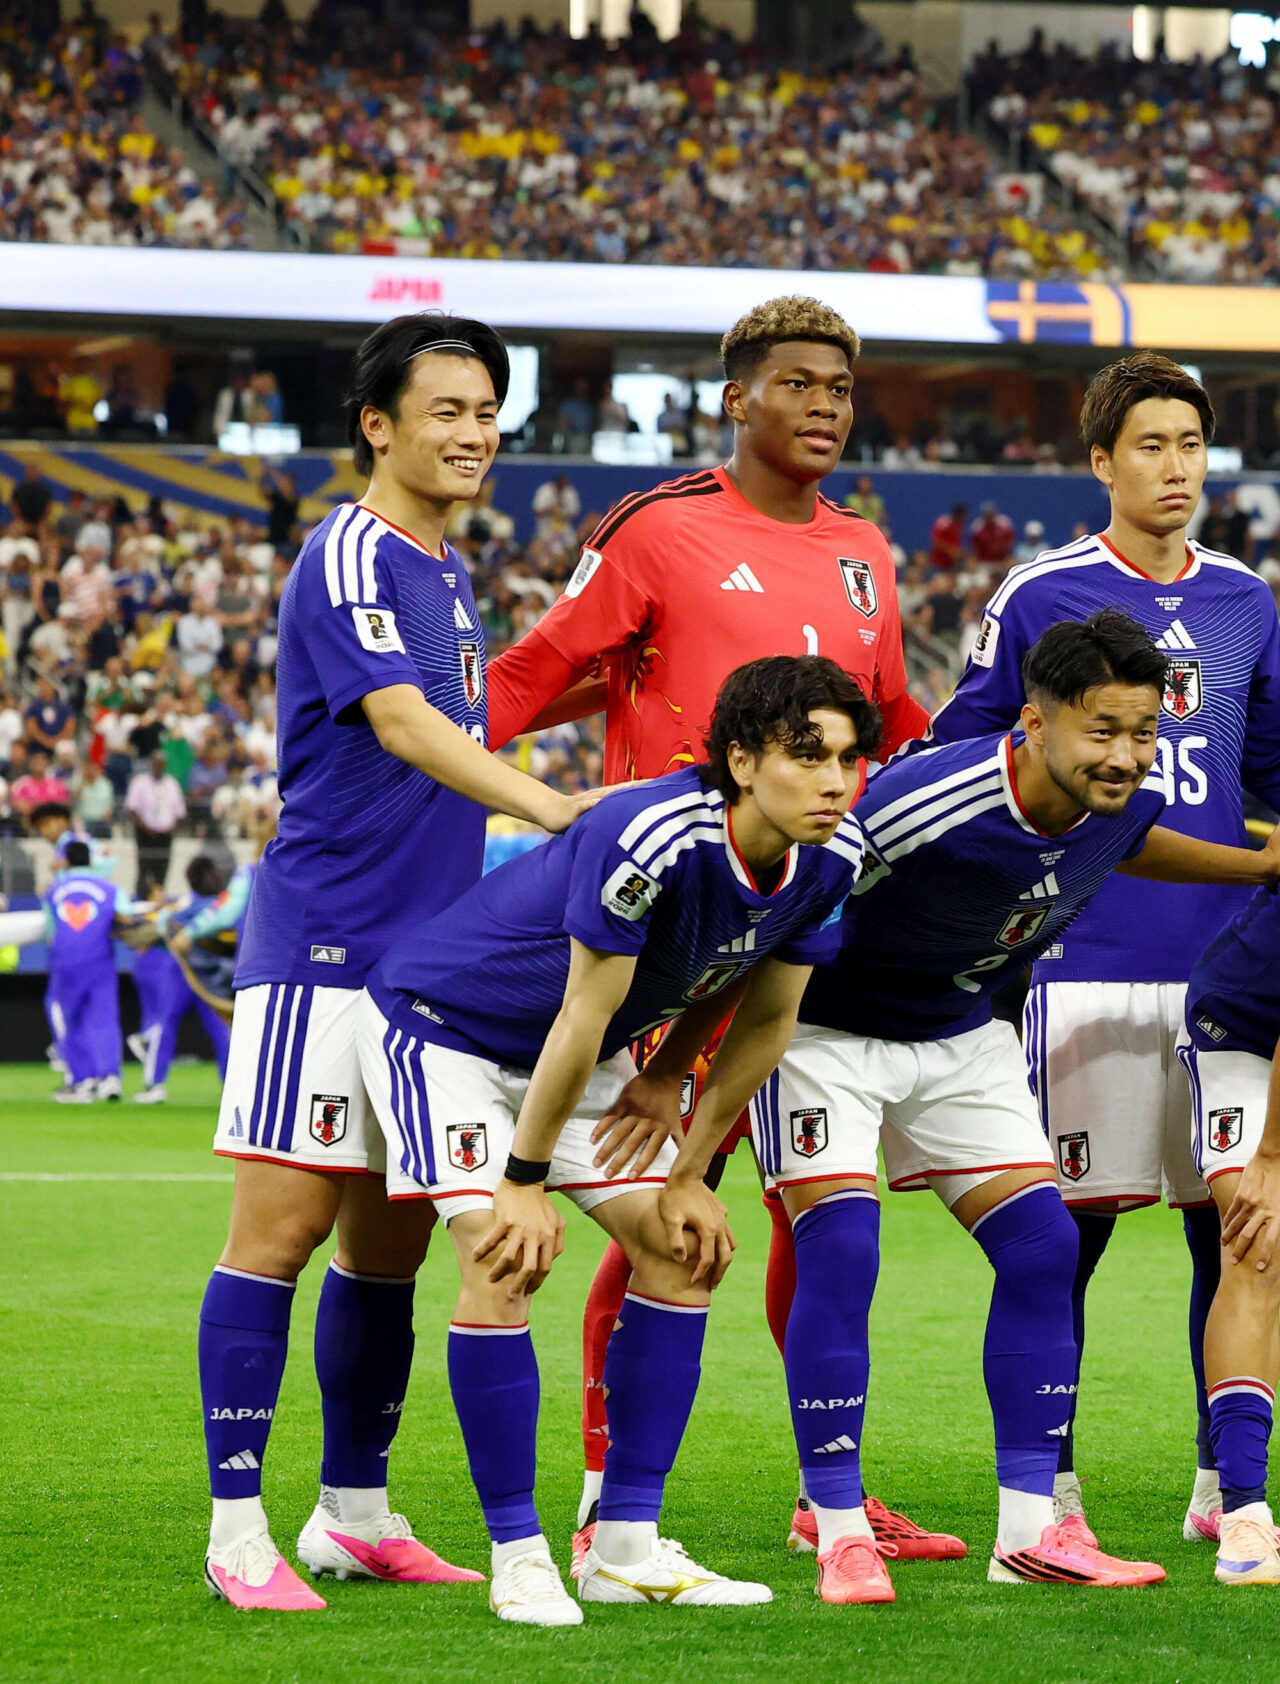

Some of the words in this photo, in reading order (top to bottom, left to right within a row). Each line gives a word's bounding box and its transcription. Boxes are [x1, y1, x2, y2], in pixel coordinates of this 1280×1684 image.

[1171, 702, 1190, 711] JFA
[1157, 736, 1208, 806] 15
[608, 900, 629, 915] 2026
[953, 953, 1009, 993] 2
[1035, 1384, 1078, 1395] JAP
[798, 1395, 864, 1410] JAPAN
